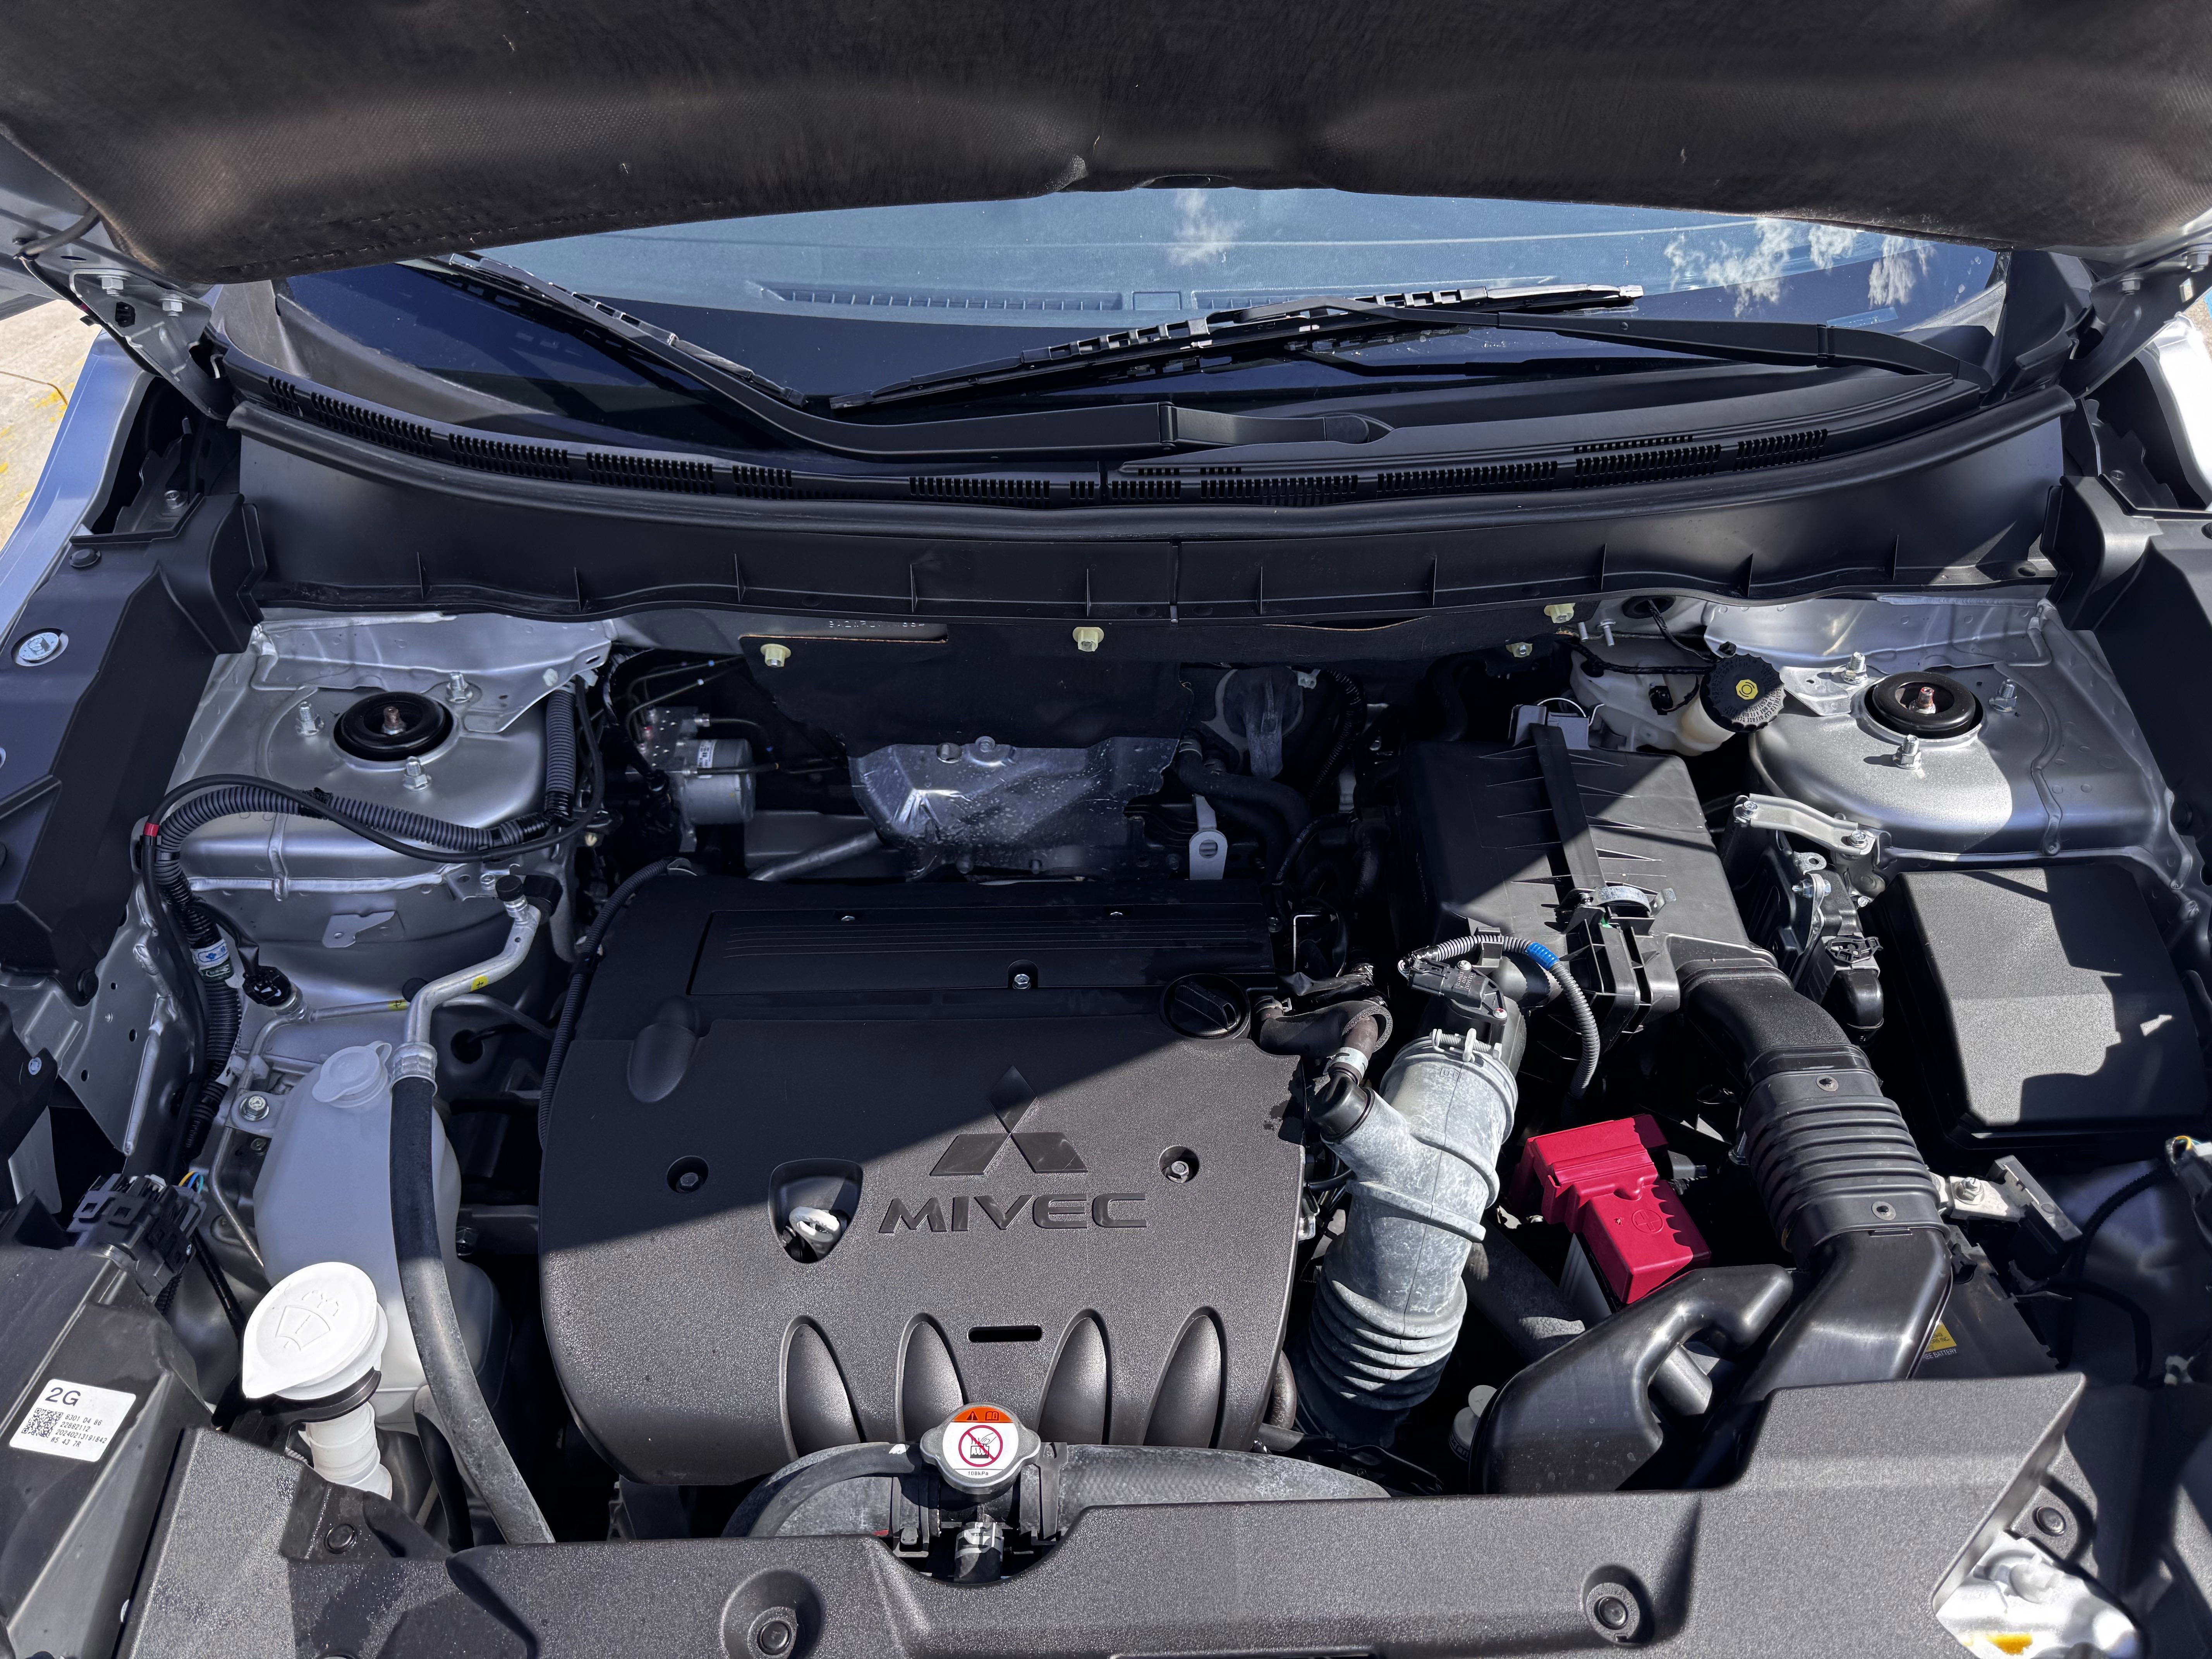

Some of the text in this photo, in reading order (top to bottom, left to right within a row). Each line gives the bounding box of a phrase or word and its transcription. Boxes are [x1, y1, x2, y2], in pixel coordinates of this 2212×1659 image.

[878, 1193, 1147, 1233] MIVEC
[1933, 1348, 1957, 1358] BATTERY
[45, 1387, 81, 1407] 2G
